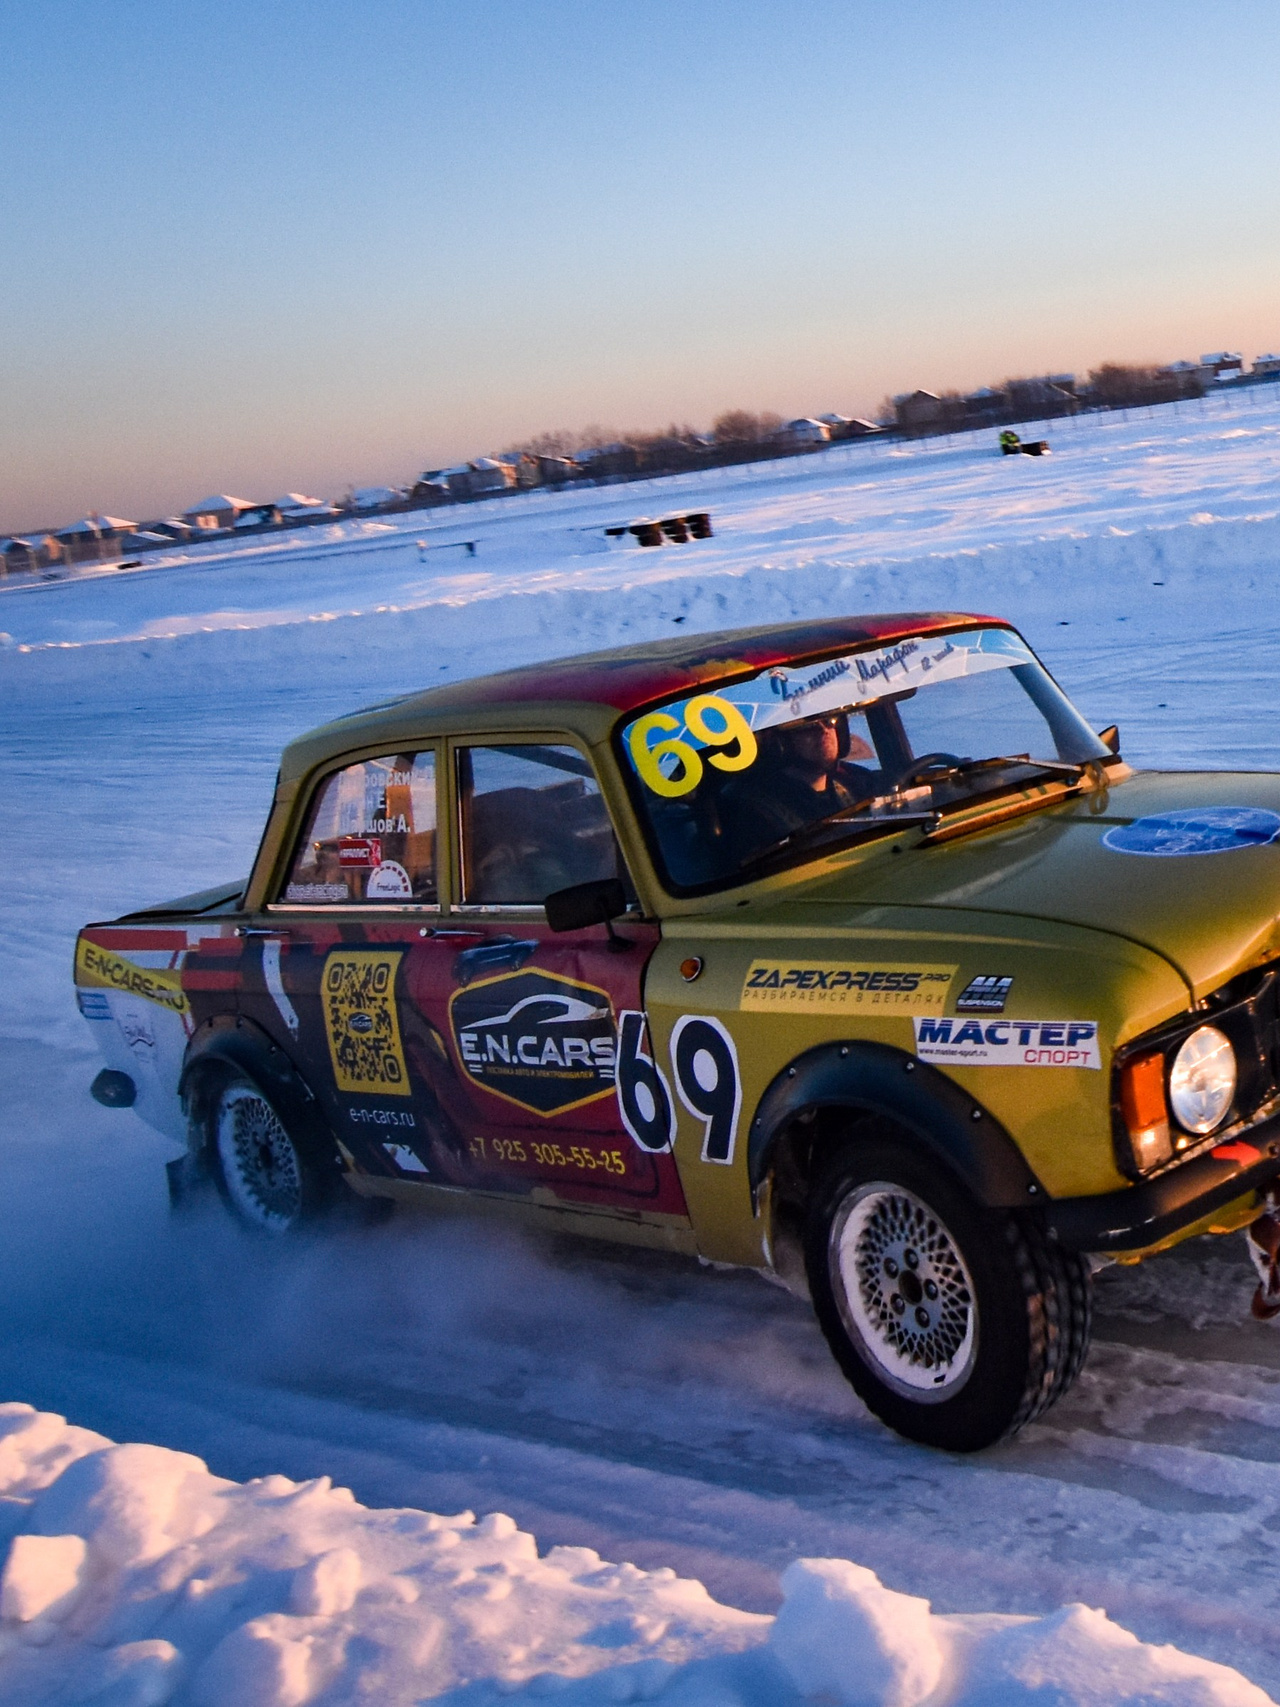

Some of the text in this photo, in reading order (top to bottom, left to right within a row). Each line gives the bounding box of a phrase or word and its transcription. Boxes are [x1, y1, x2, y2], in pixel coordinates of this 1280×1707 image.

[629, 696, 758, 797] 69
[744, 990, 943, 1004] РАЗБИРАЕМСЯ В ДЕТАЛЯХ
[918, 1018, 1096, 1047] МАСТЕР
[460, 1032, 615, 1067] E.N.CARS
[1023, 1049, 1092, 1065] СПОРТ
[615, 1010, 742, 1165] 69
[350, 1108, 416, 1127] e-n-cars.ru
[469, 1137, 626, 1175] +7 925 305-55-25
